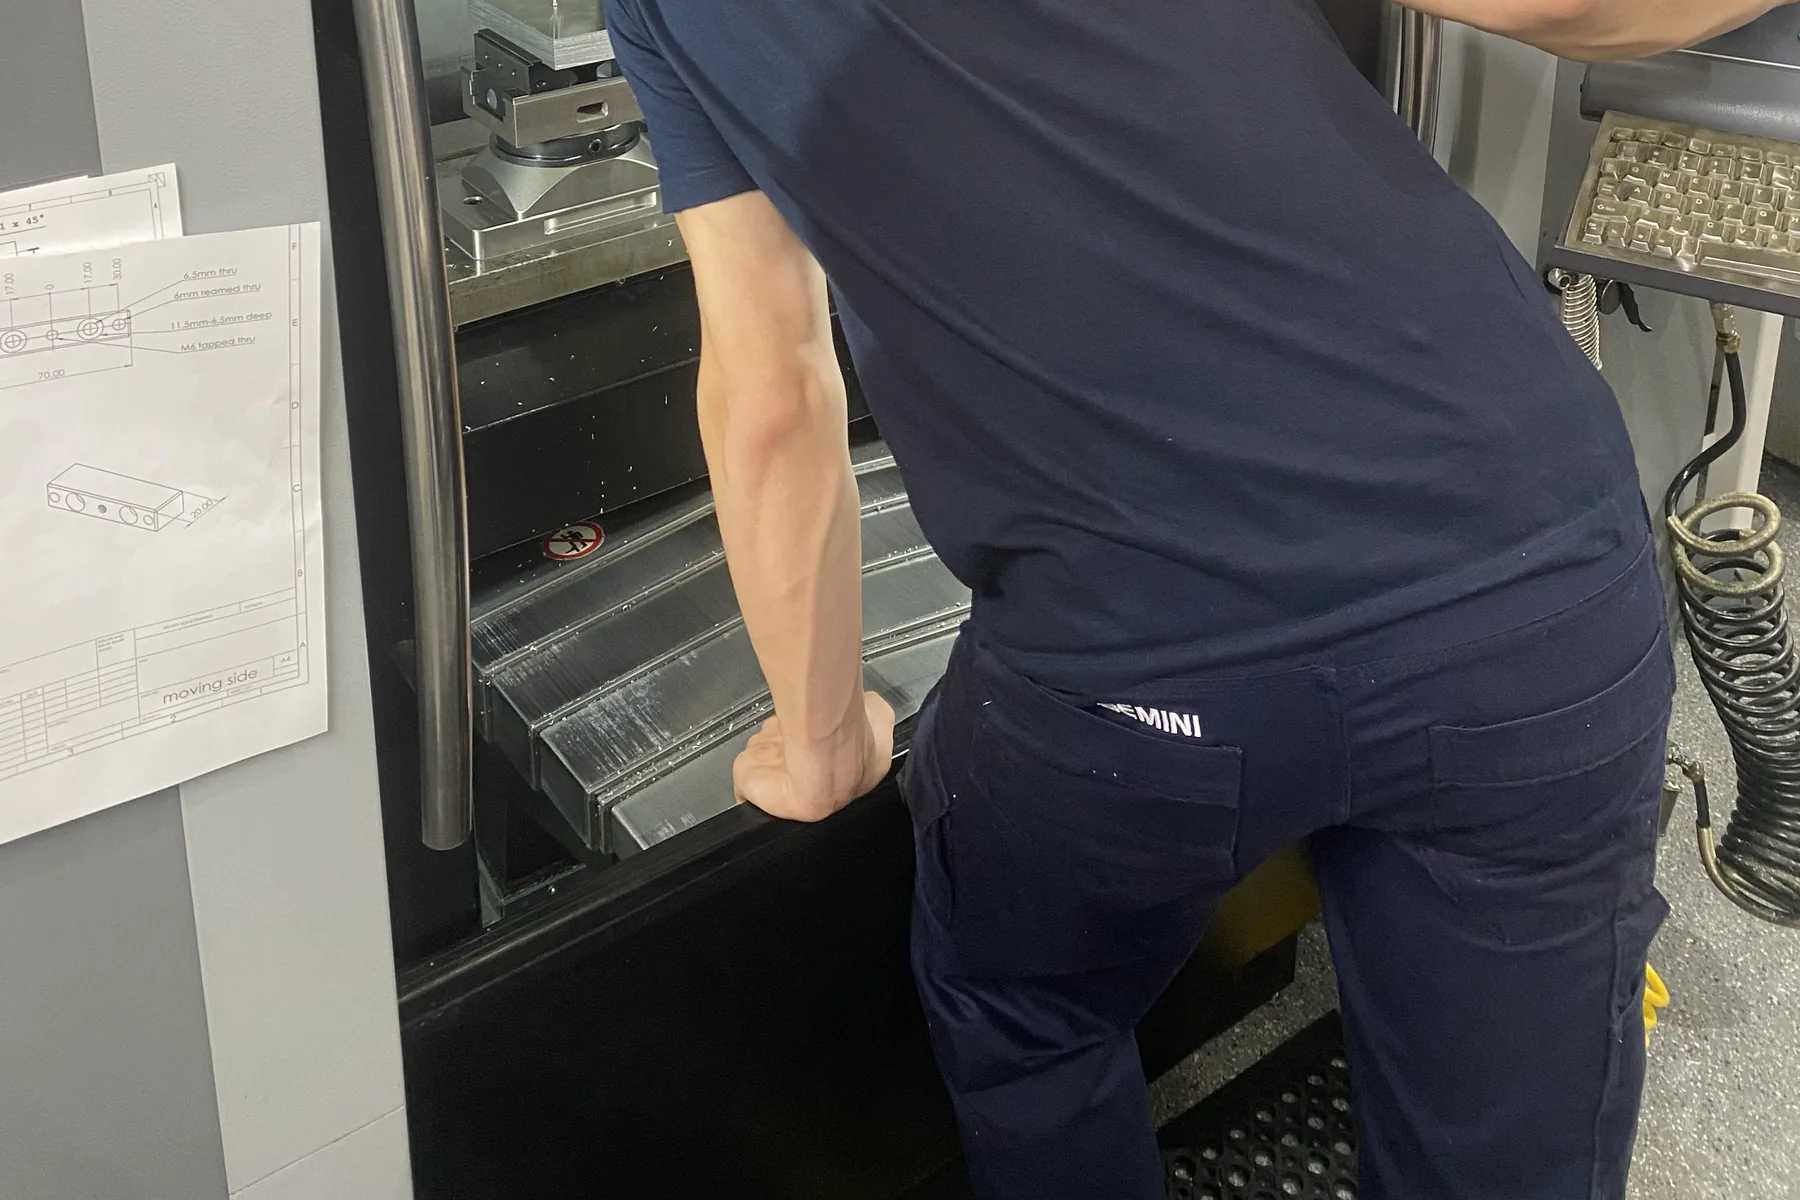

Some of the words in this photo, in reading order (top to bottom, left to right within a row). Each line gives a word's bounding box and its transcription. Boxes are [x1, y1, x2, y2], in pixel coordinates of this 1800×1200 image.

[219, 266, 238, 276] thru
[201, 285, 241, 297] reamed
[242, 282, 262, 292] thru
[246, 311, 273, 321] deep
[198, 337, 235, 351] tapped
[237, 336, 256, 345] thru
[163, 679, 223, 705] moving
[227, 668, 258, 687] side
